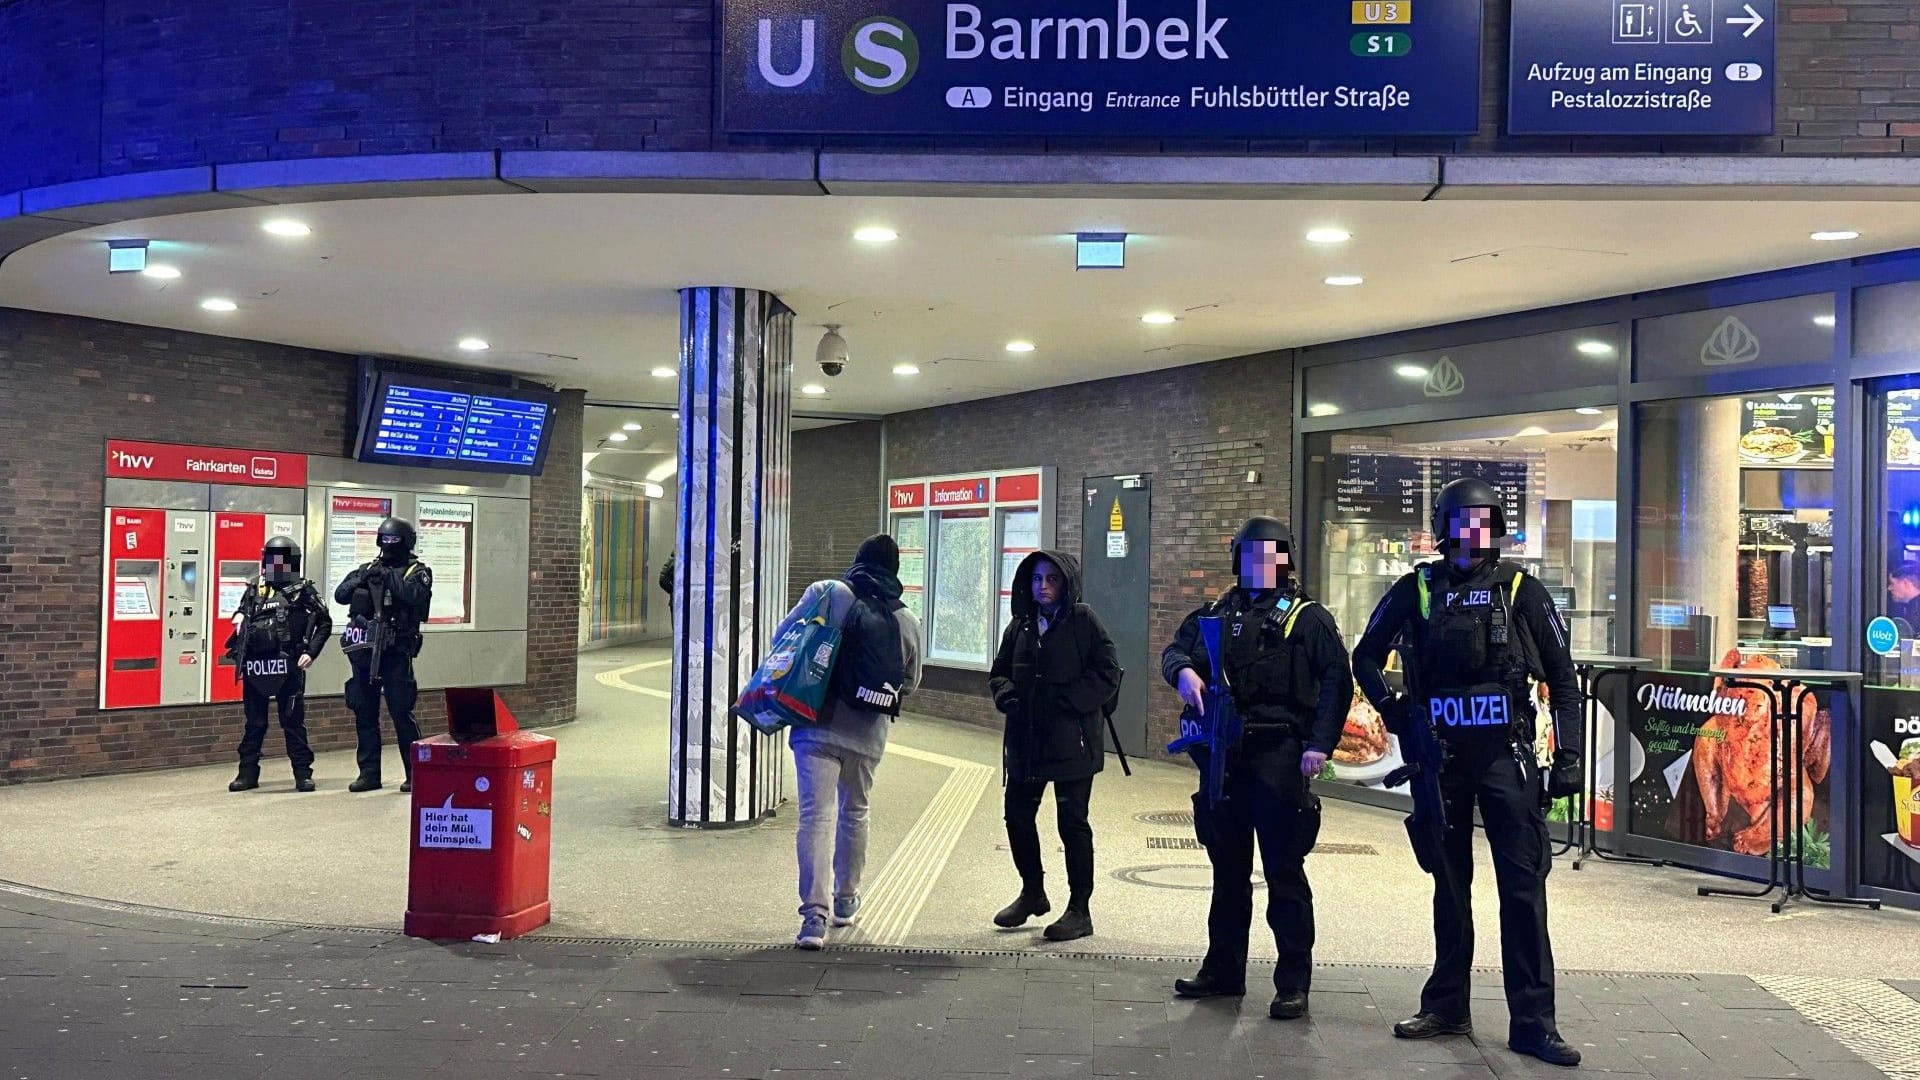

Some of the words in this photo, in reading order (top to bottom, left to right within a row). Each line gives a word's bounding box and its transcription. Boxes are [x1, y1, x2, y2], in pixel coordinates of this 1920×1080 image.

[946, 0, 1229, 60] Barmbek
[758, 19, 815, 87] U
[854, 22, 907, 88] S
[1527, 63, 1595, 84] Aufzug
[1600, 67, 1629, 81] am
[1635, 63, 1712, 84] Eingang
[1738, 66, 1749, 79] B
[961, 88, 976, 106] A
[1004, 86, 1093, 112] Eingang
[1105, 91, 1180, 108] Entrance
[1190, 85, 1329, 108] Fuhlsbüttler
[1334, 84, 1410, 111] Straße
[1551, 89, 1712, 111] Pestalozzistraße
[186, 459, 246, 474] Fahrkarten
[934, 487, 973, 503] Information
[246, 658, 288, 676] POLIZEI
[856, 685, 893, 708] PUMA
[1636, 683, 1746, 716] Hähnchen
[1430, 695, 1509, 727] POLIZEI
[1671, 722, 1688, 734] und
[425, 812, 449, 823] Hier
[450, 812, 468, 823] hat
[425, 823, 448, 833] dein
[451, 822, 474, 833] Müll
[425, 833, 482, 845] Heimspiel.
